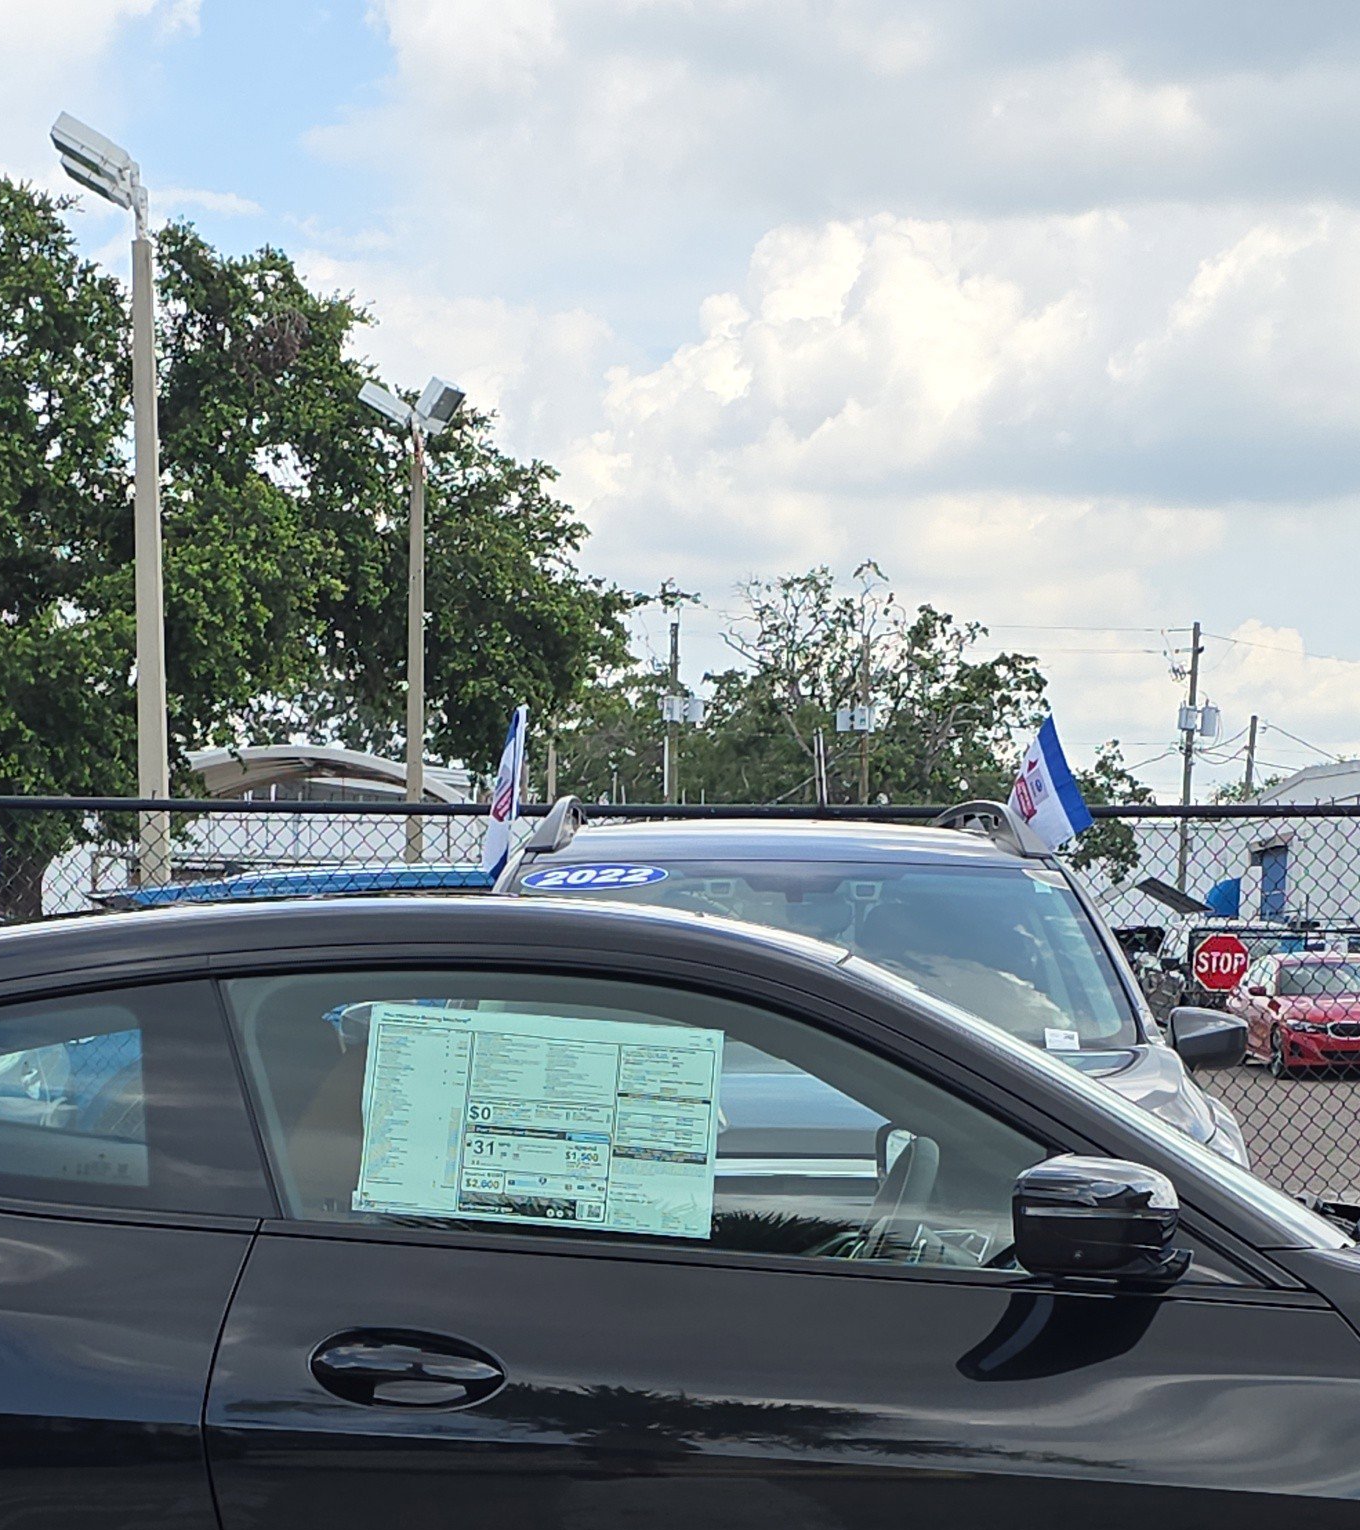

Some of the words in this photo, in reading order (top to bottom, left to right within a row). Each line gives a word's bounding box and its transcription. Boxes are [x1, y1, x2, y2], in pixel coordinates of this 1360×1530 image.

[535, 869, 654, 887] 2022
[1196, 951, 1246, 975] STOP
[469, 1105, 491, 1120] $0
[472, 1140, 495, 1156] 31
